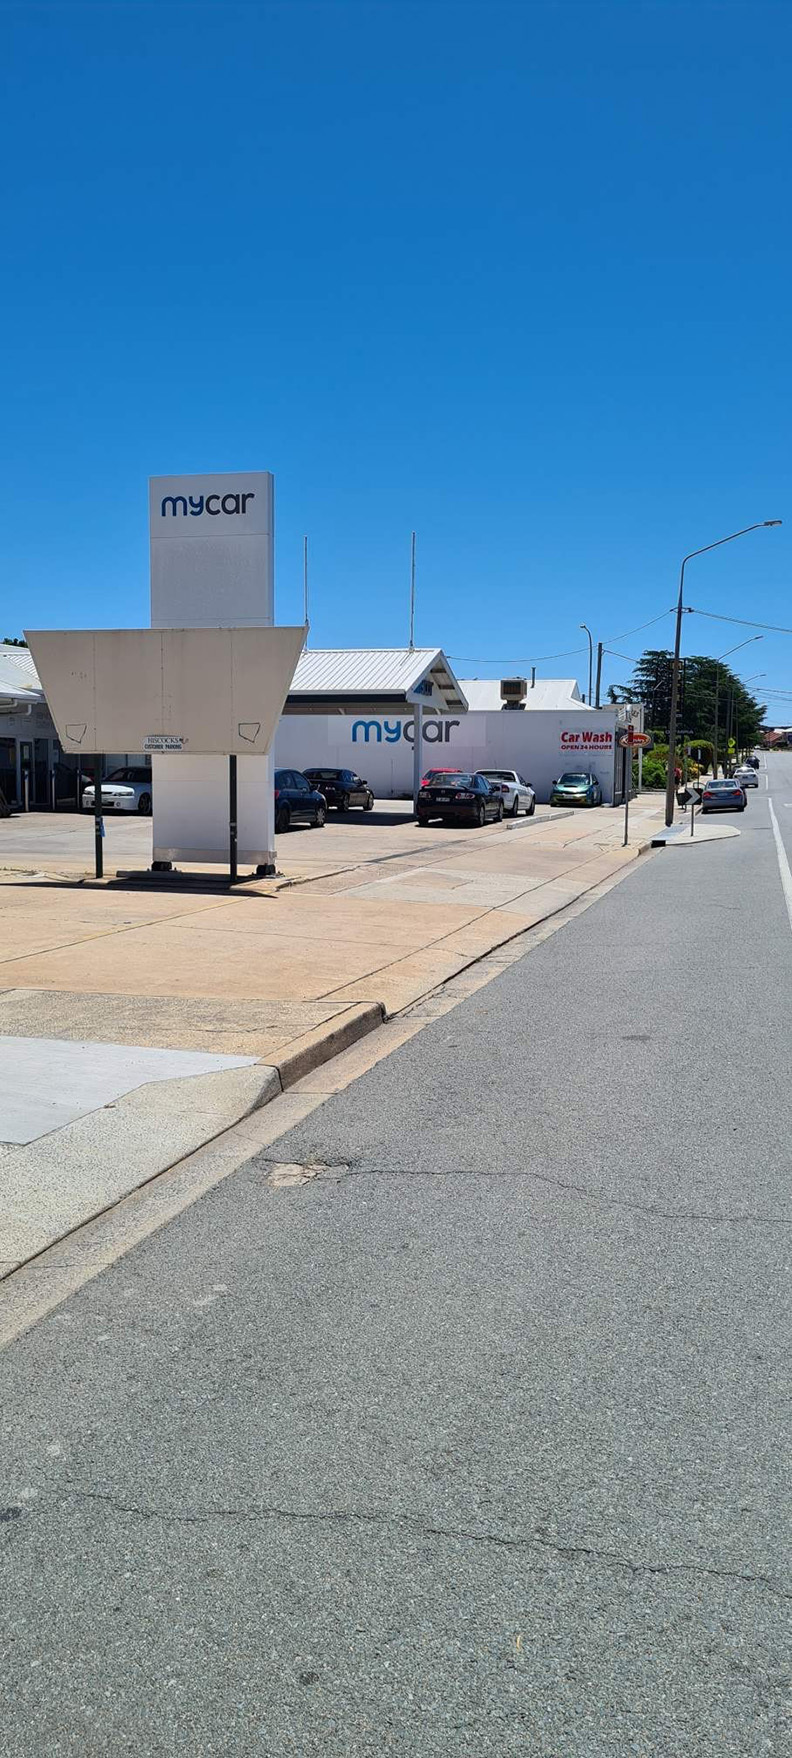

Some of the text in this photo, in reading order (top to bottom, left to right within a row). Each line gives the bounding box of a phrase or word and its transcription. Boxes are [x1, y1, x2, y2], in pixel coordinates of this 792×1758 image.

[161, 492, 255, 517] mycar
[351, 720, 460, 743] mycar
[561, 731, 613, 743] Car Wash
